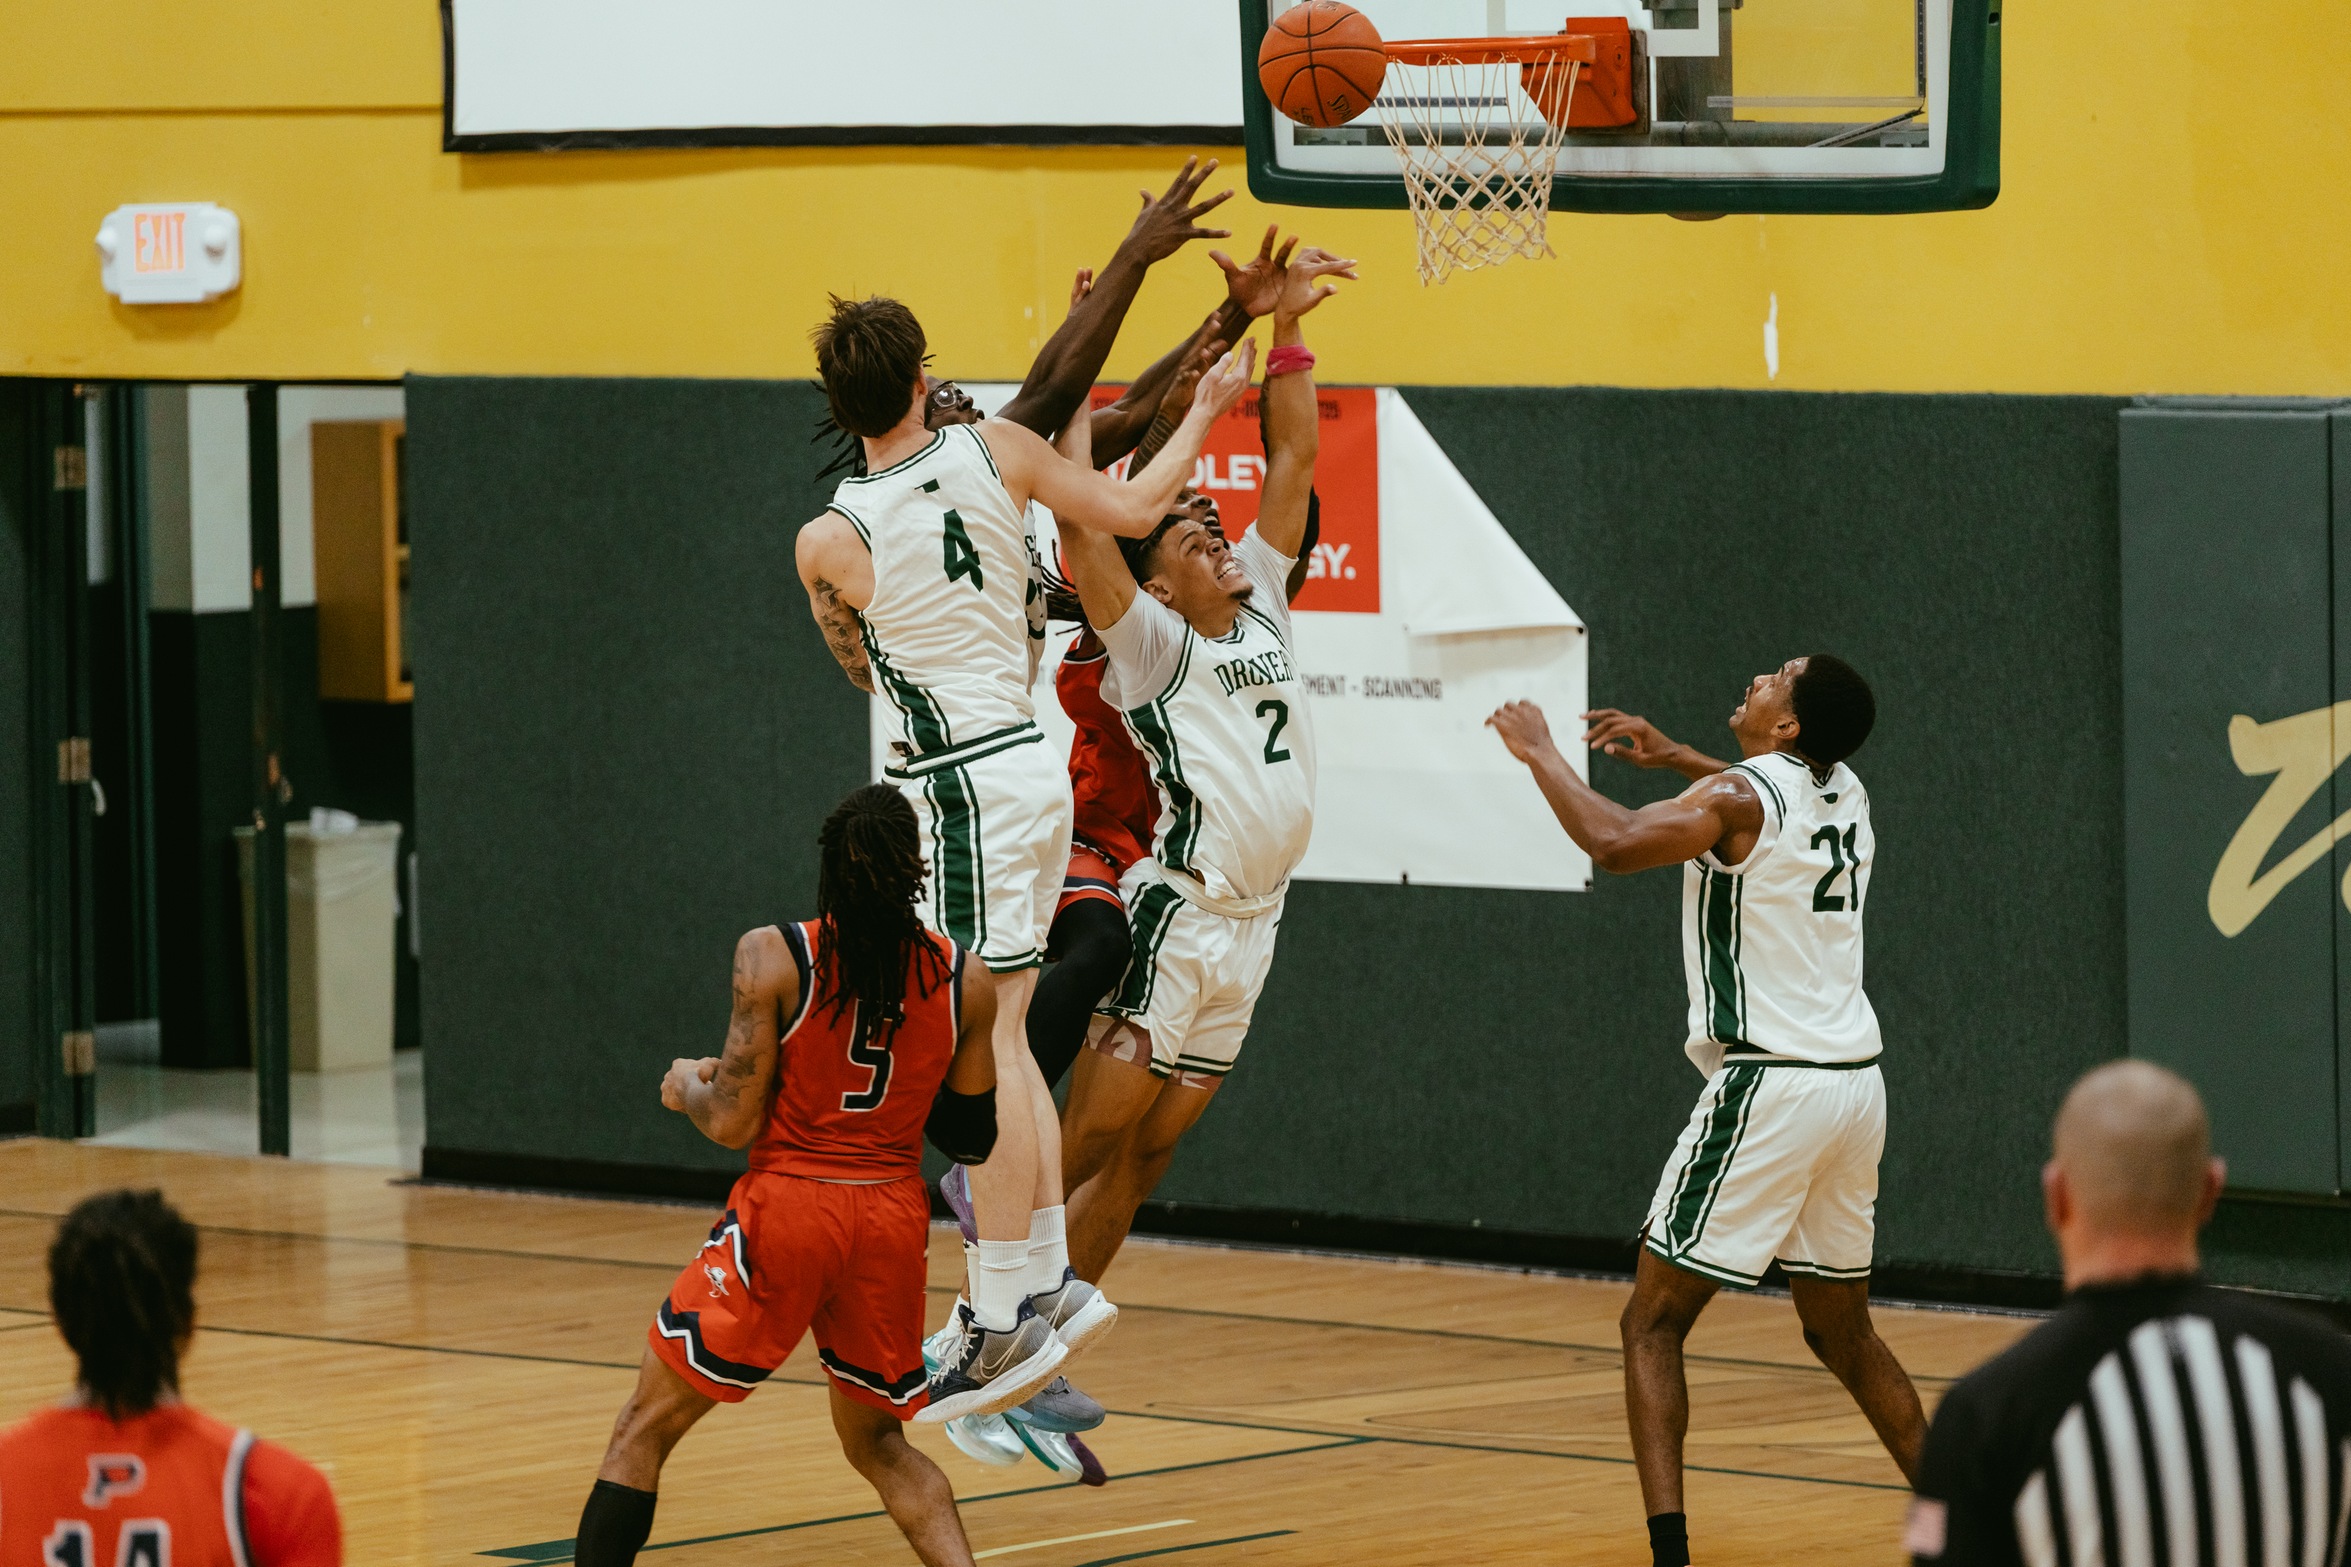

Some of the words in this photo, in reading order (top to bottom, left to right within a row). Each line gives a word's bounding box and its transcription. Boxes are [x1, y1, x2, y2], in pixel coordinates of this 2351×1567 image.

[133, 211, 187, 272] EXIT
[943, 508, 984, 593] 4
[1362, 676, 1442, 699] SCANNING
[1255, 699, 1291, 765] 2
[1810, 822, 1861, 912] 21
[840, 998, 904, 1112] 5
[82, 1453, 147, 1509] P
